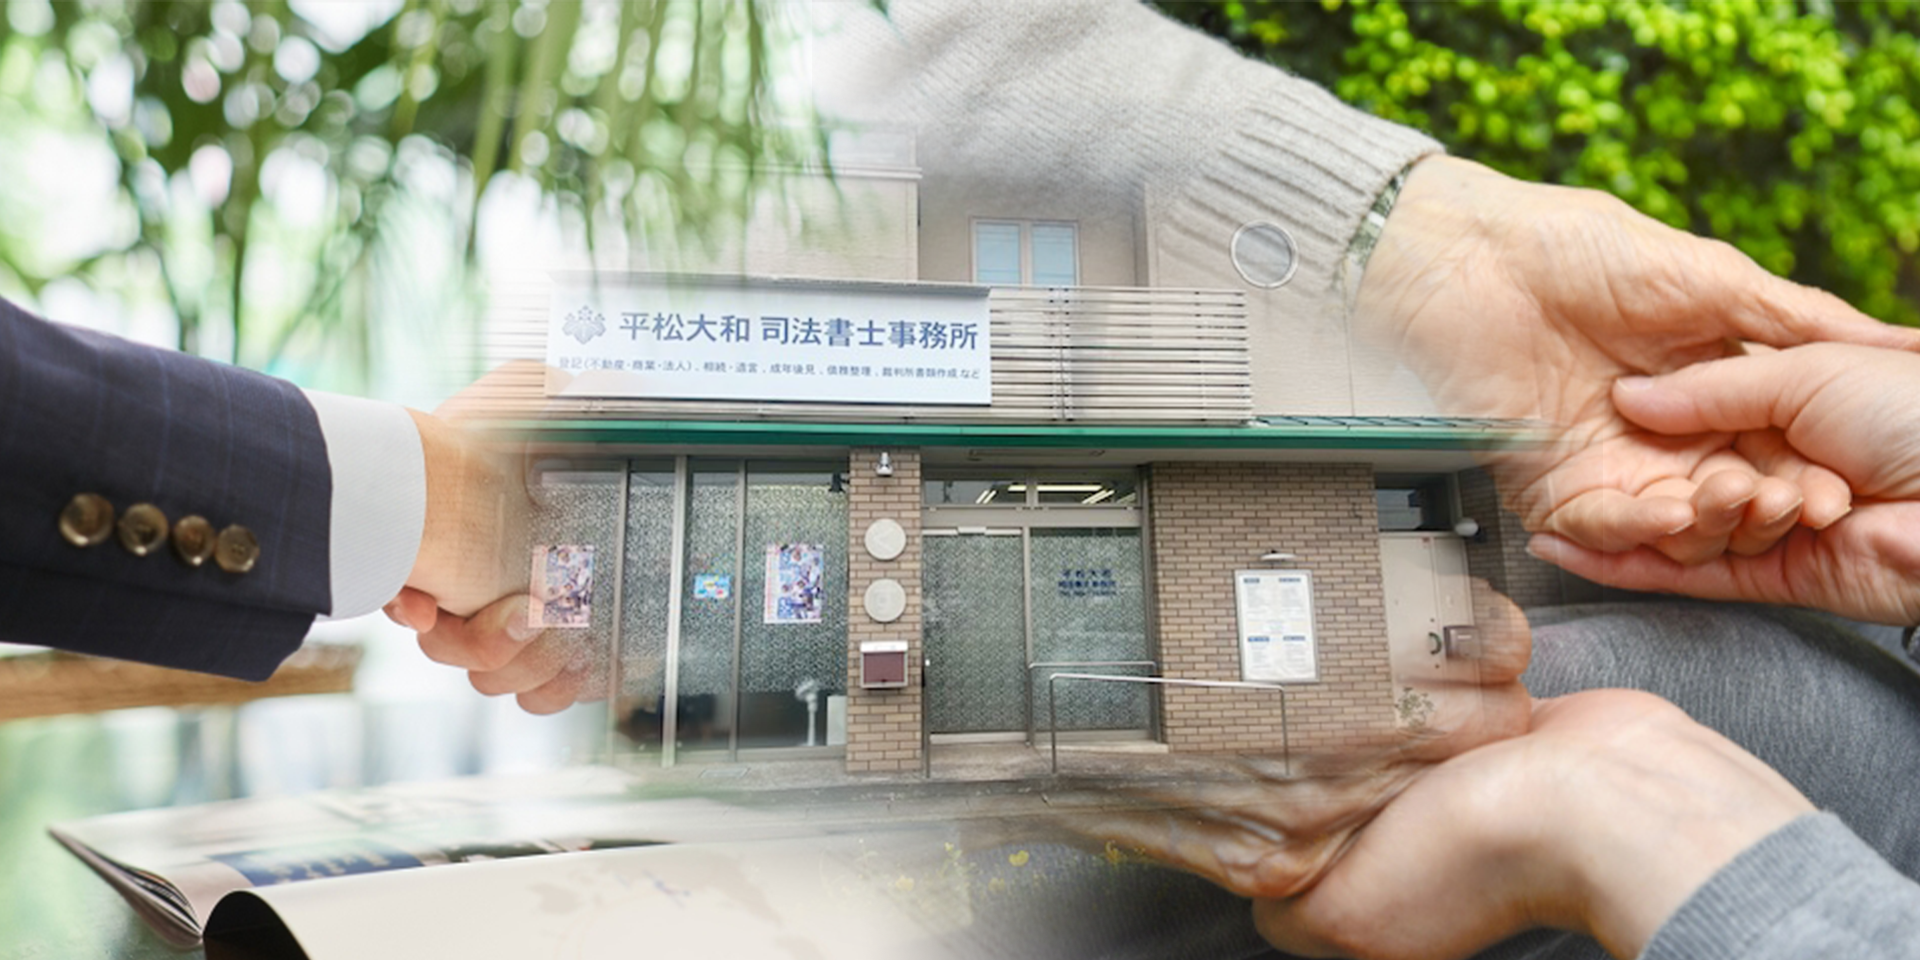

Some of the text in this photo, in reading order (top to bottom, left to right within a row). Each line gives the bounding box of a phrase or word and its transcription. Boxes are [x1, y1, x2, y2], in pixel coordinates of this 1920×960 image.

[619, 311, 979, 350] 平松大和 司法書士事務所
